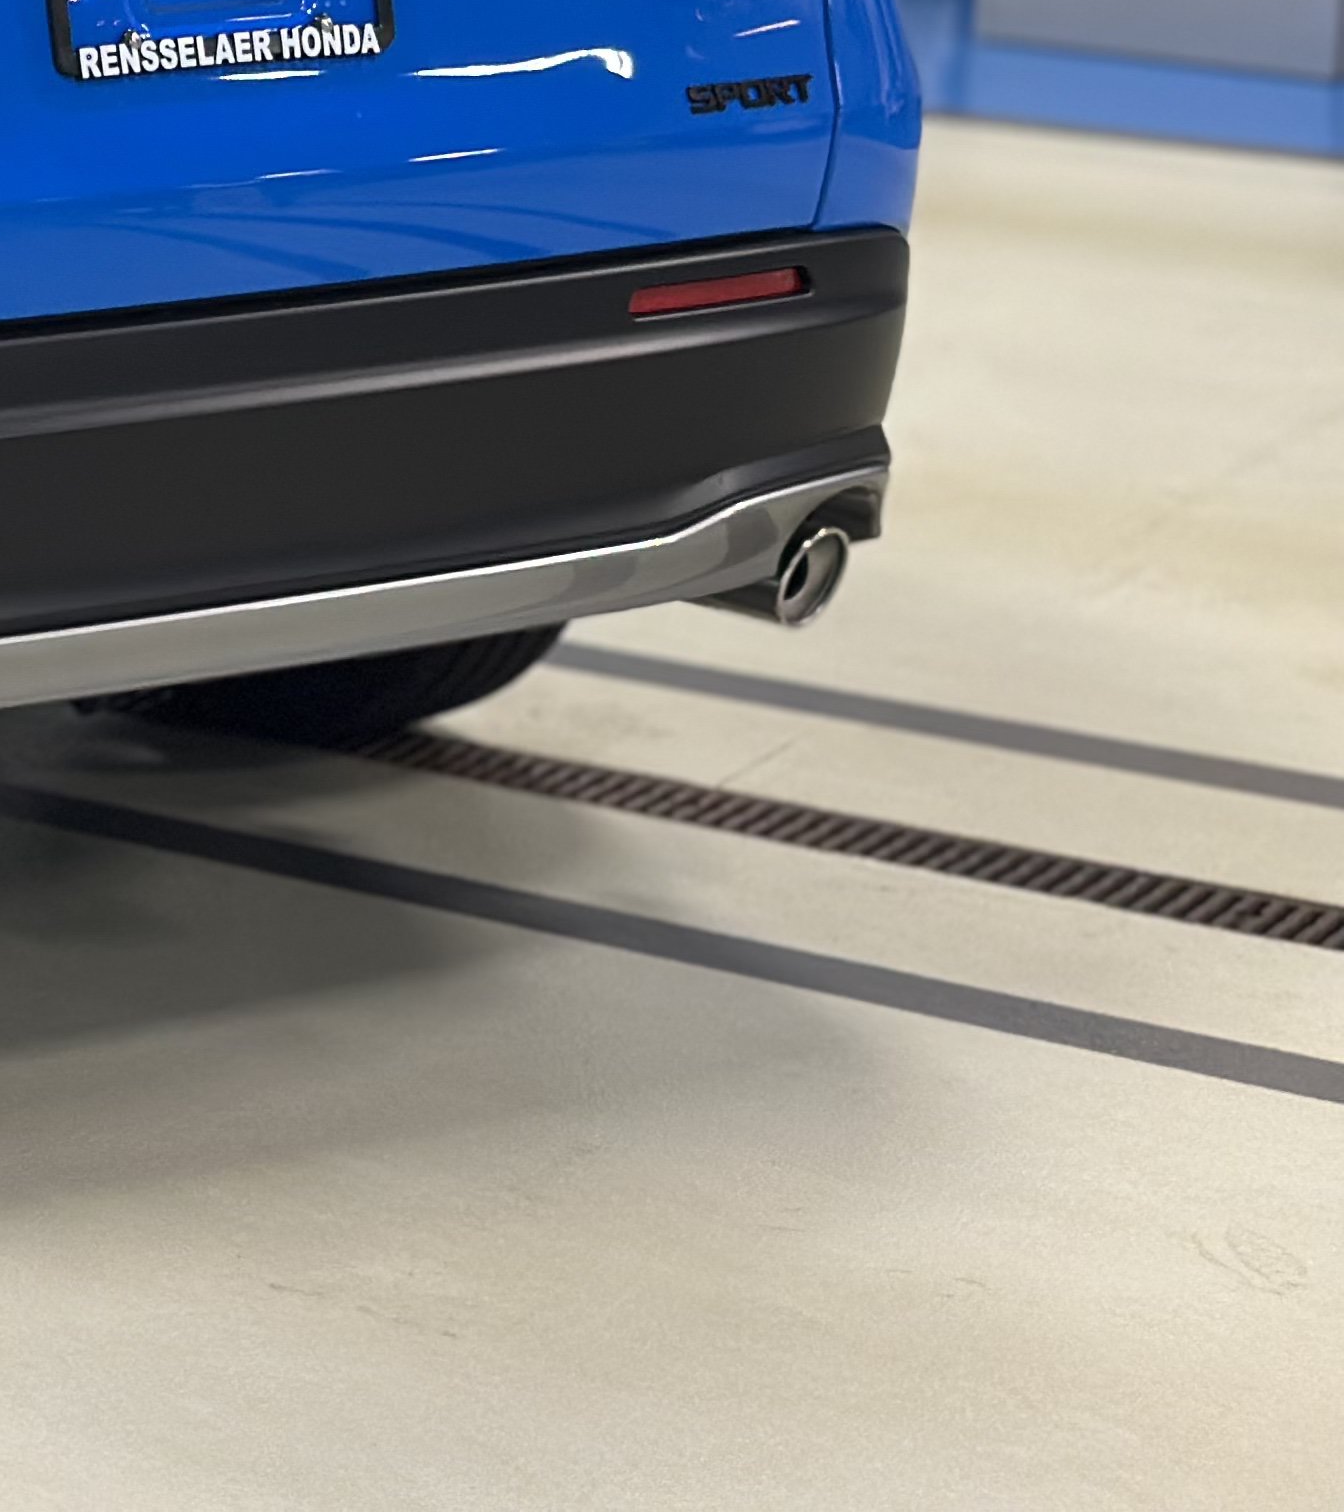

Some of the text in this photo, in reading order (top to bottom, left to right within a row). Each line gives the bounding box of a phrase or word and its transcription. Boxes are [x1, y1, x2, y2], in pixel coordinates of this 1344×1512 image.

[79, 23, 381, 80] RENSSELAER HONDA
[686, 73, 813, 115] SPORT
